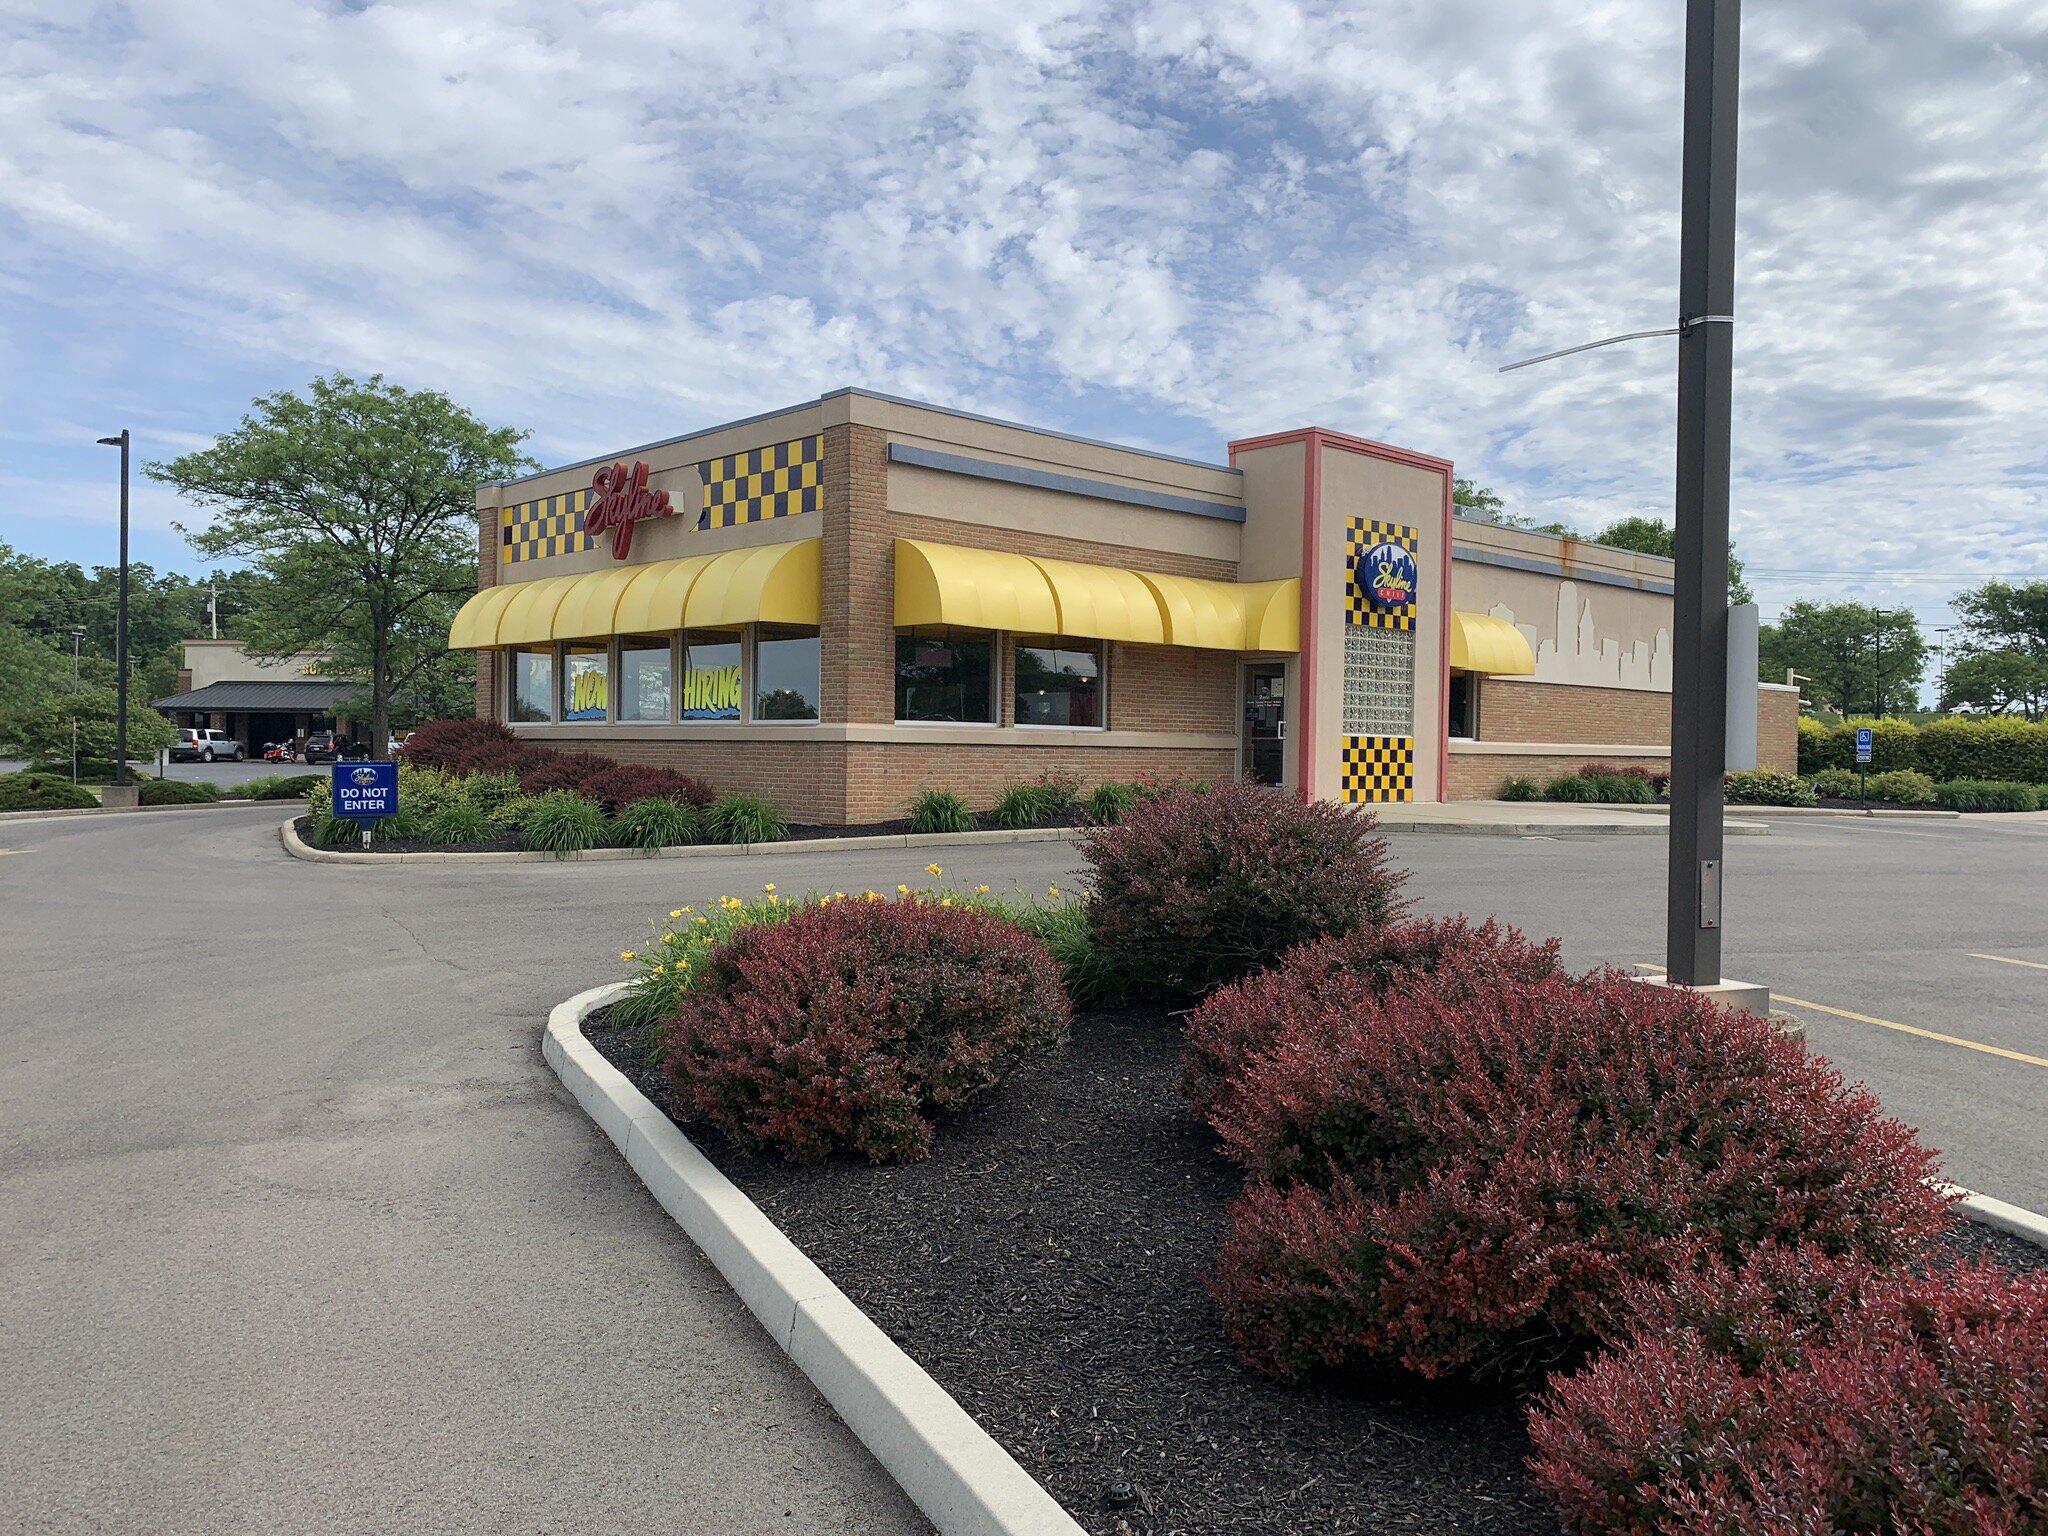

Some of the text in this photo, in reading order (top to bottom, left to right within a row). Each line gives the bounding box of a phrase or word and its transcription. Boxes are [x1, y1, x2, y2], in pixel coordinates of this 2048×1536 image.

[1373, 561, 1412, 593] Skyline
[683, 665, 742, 712] HIRING
[340, 788, 389, 798] DO NOT
[344, 800, 385, 810] ENTER
